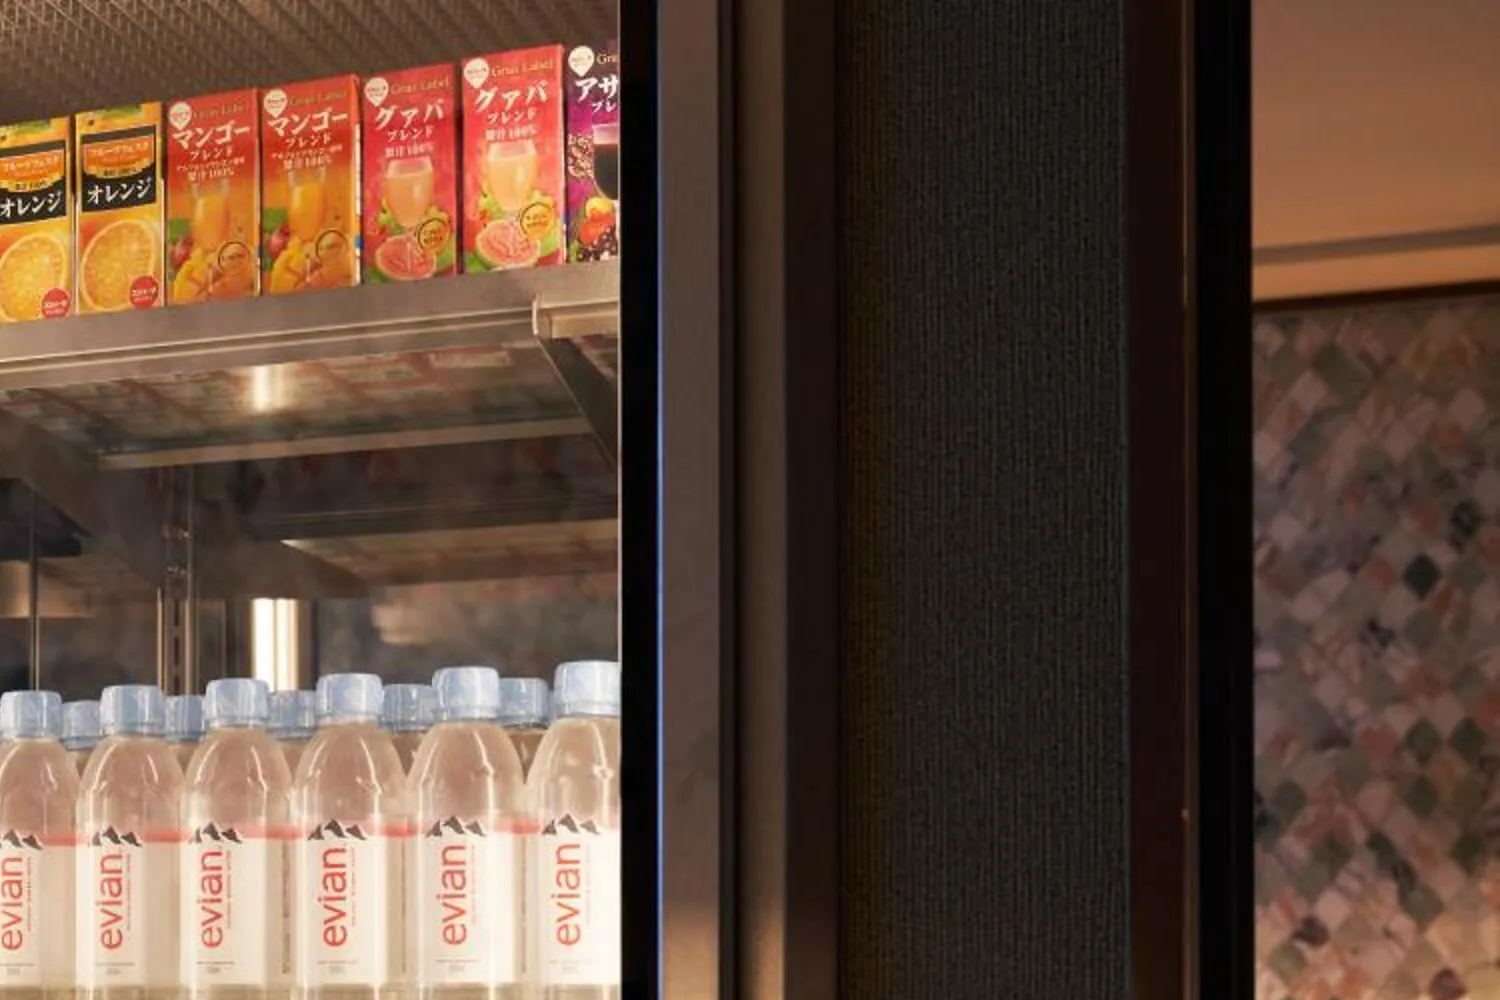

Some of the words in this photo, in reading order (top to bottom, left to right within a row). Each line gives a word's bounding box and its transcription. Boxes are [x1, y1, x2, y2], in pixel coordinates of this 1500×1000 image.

[475, 79, 548, 112] グァバ
[574, 74, 619, 103] アサ
[268, 107, 348, 137] マンゴー
[375, 98, 444, 131] グァバ
[487, 107, 539, 124] ブレンド
[172, 119, 250, 149] マンゴー
[286, 132, 332, 148] ブレンド
[388, 125, 434, 141] ブレンド
[189, 146, 233, 161] ブレンド
[0, 190, 62, 219] オレンジ
[87, 177, 152, 205] オレンジ
[94, 852, 124, 950] evian
[197, 850, 223, 949] evian
[317, 847, 348, 948] evian
[436, 842, 467, 946] evian
[551, 842, 582, 946] evian
